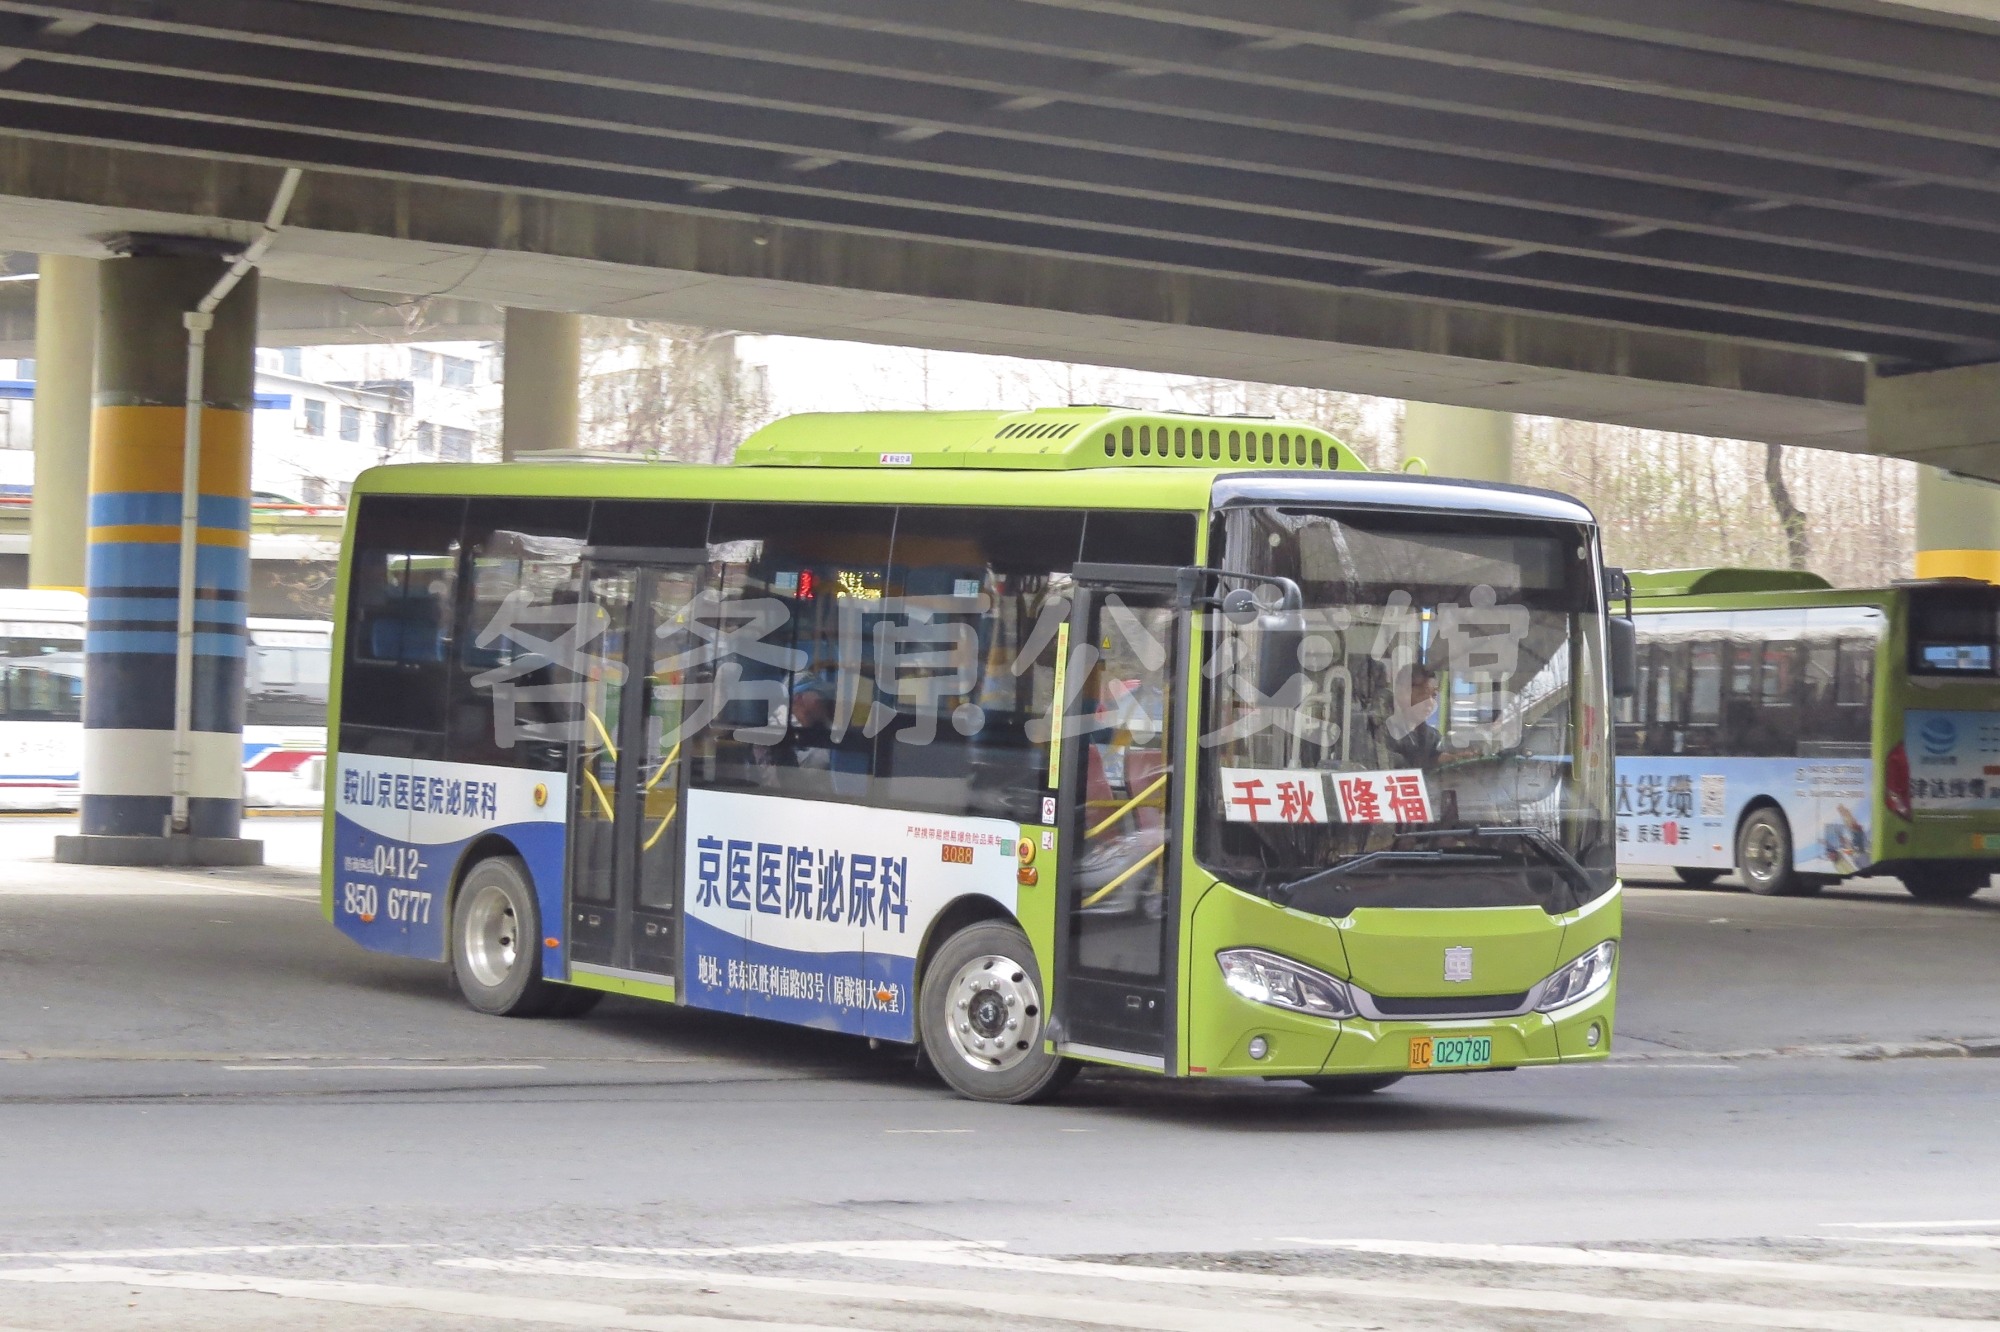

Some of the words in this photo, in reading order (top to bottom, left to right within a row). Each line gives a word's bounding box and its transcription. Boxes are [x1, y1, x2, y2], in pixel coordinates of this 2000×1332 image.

[344, 768, 497, 820] 鞍山京医医院泌尿科
[1231, 779, 1318, 823] 千秋
[1338, 775, 1429, 823] 隆福
[942, 845, 973, 864] 3088
[344, 882, 378, 917] 850
[387, 887, 432, 925] 6777
[696, 835, 908, 934] 京医医院泌尿科
[1436, 1039, 1491, 1066] 02978D
